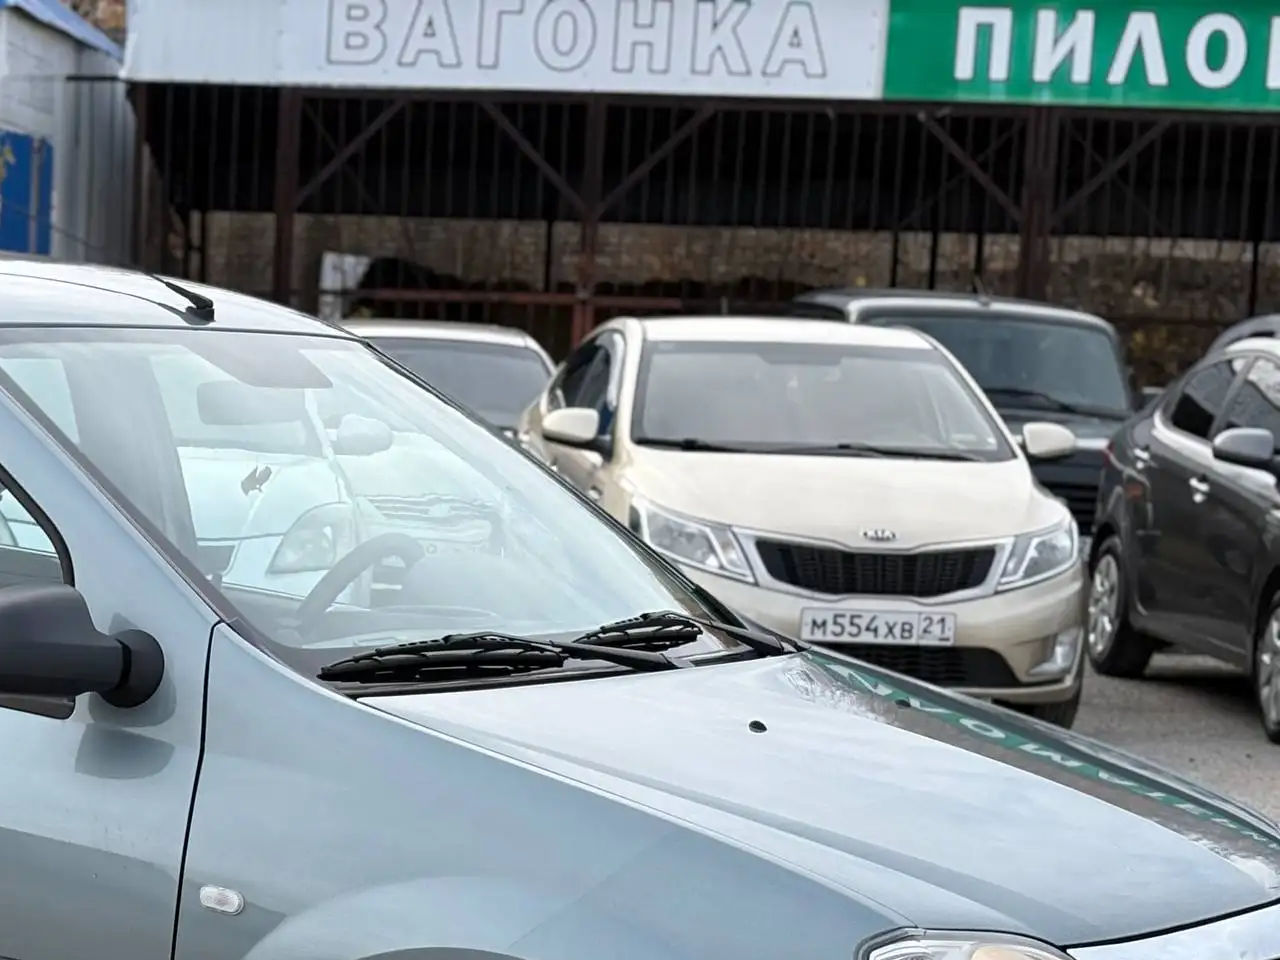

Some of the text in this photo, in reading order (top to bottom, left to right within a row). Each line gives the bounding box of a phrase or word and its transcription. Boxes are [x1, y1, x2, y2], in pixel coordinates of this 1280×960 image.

[326, 0, 828, 78] ВАГОНКА
[953, 6, 1280, 91] ПИЛО
[922, 616, 947, 635] 21
